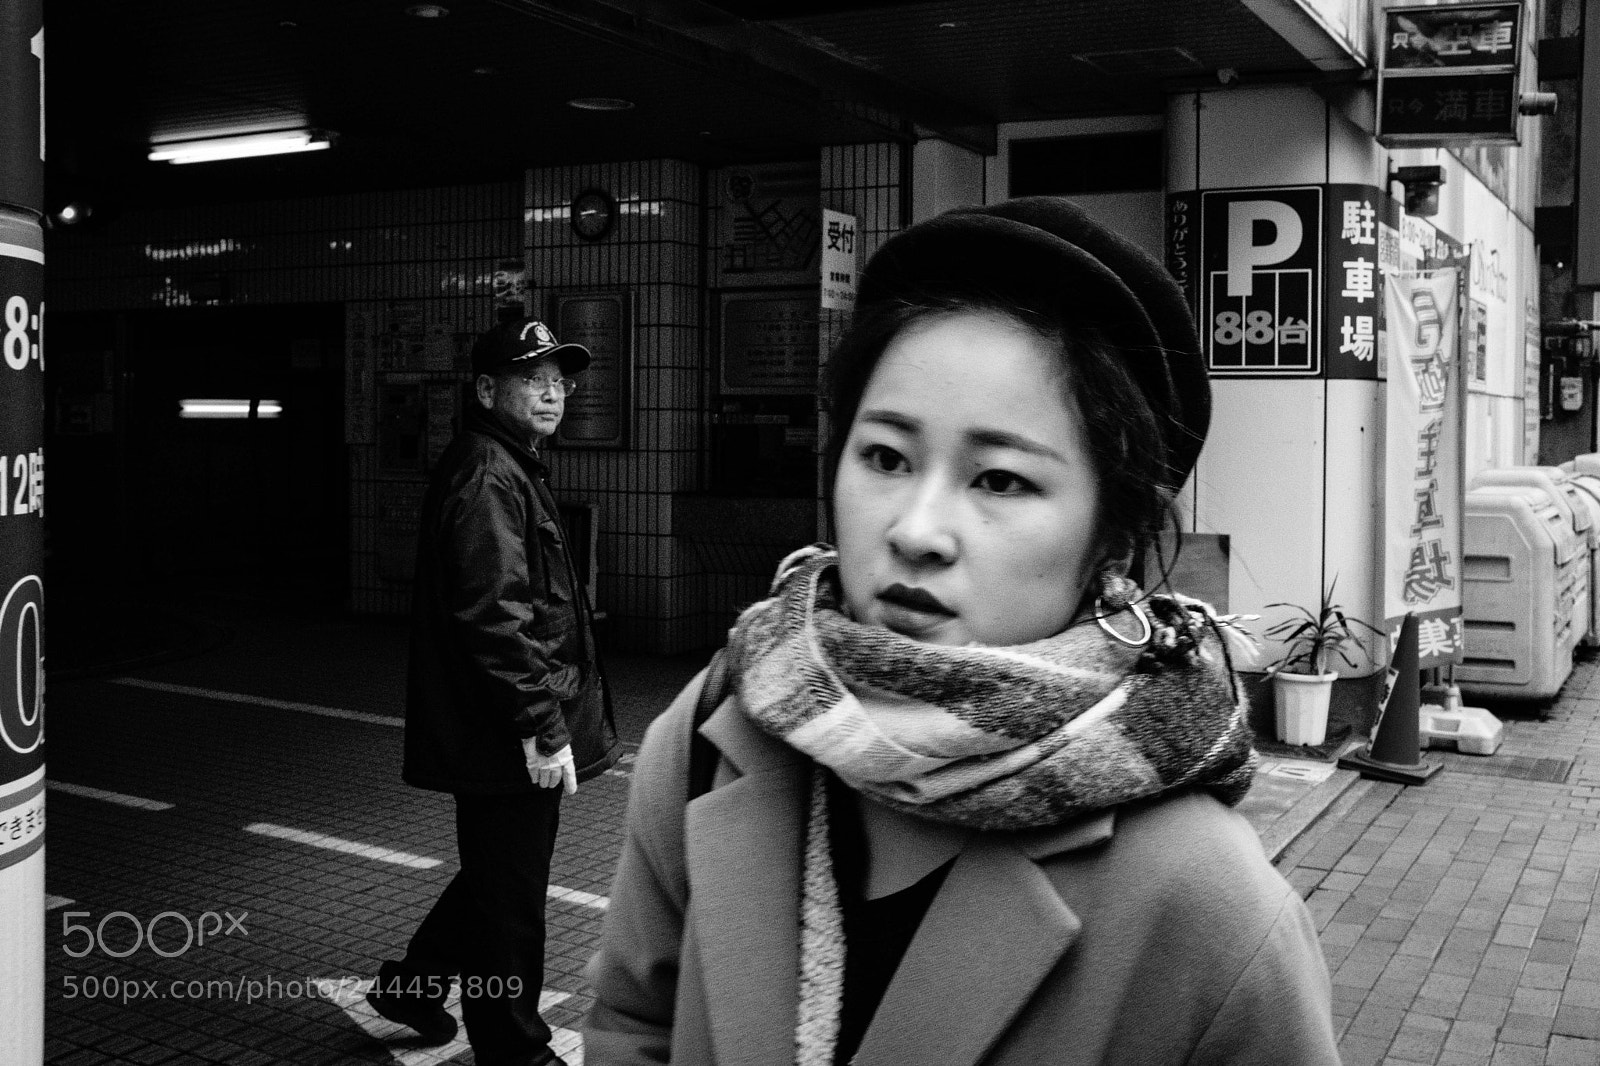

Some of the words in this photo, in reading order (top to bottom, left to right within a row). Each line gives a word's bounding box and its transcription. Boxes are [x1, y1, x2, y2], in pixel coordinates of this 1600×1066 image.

[1432, 88, 1508, 122] 満車
[827, 211, 854, 254] 受付
[1227, 200, 1303, 297] P
[1340, 200, 1385, 361] 駐車場
[1214, 310, 1308, 345] 88台
